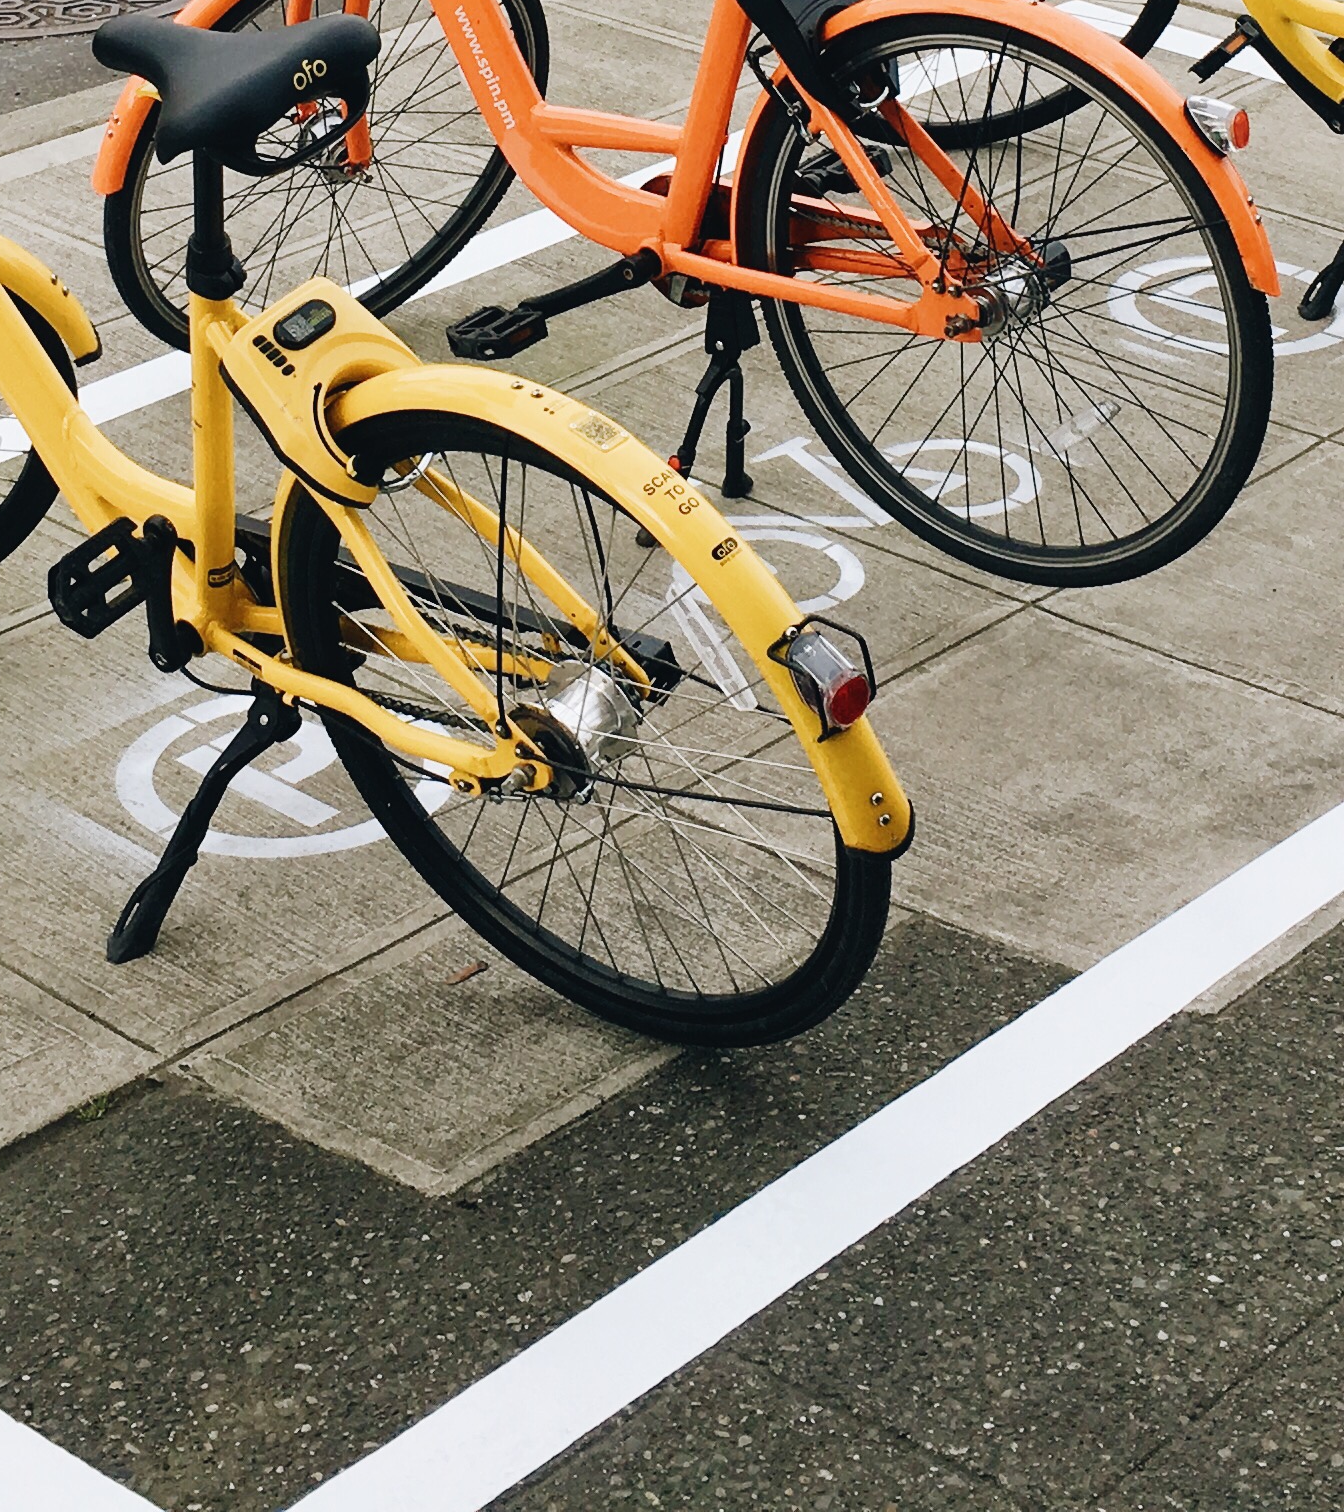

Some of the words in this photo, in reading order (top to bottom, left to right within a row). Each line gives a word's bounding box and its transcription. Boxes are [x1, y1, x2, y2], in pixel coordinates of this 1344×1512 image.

[293, 59, 328, 91] ofo
[454, 4, 516, 130] www.spin.pm
[663, 484, 686, 501] TO
[678, 496, 700, 515] GO
